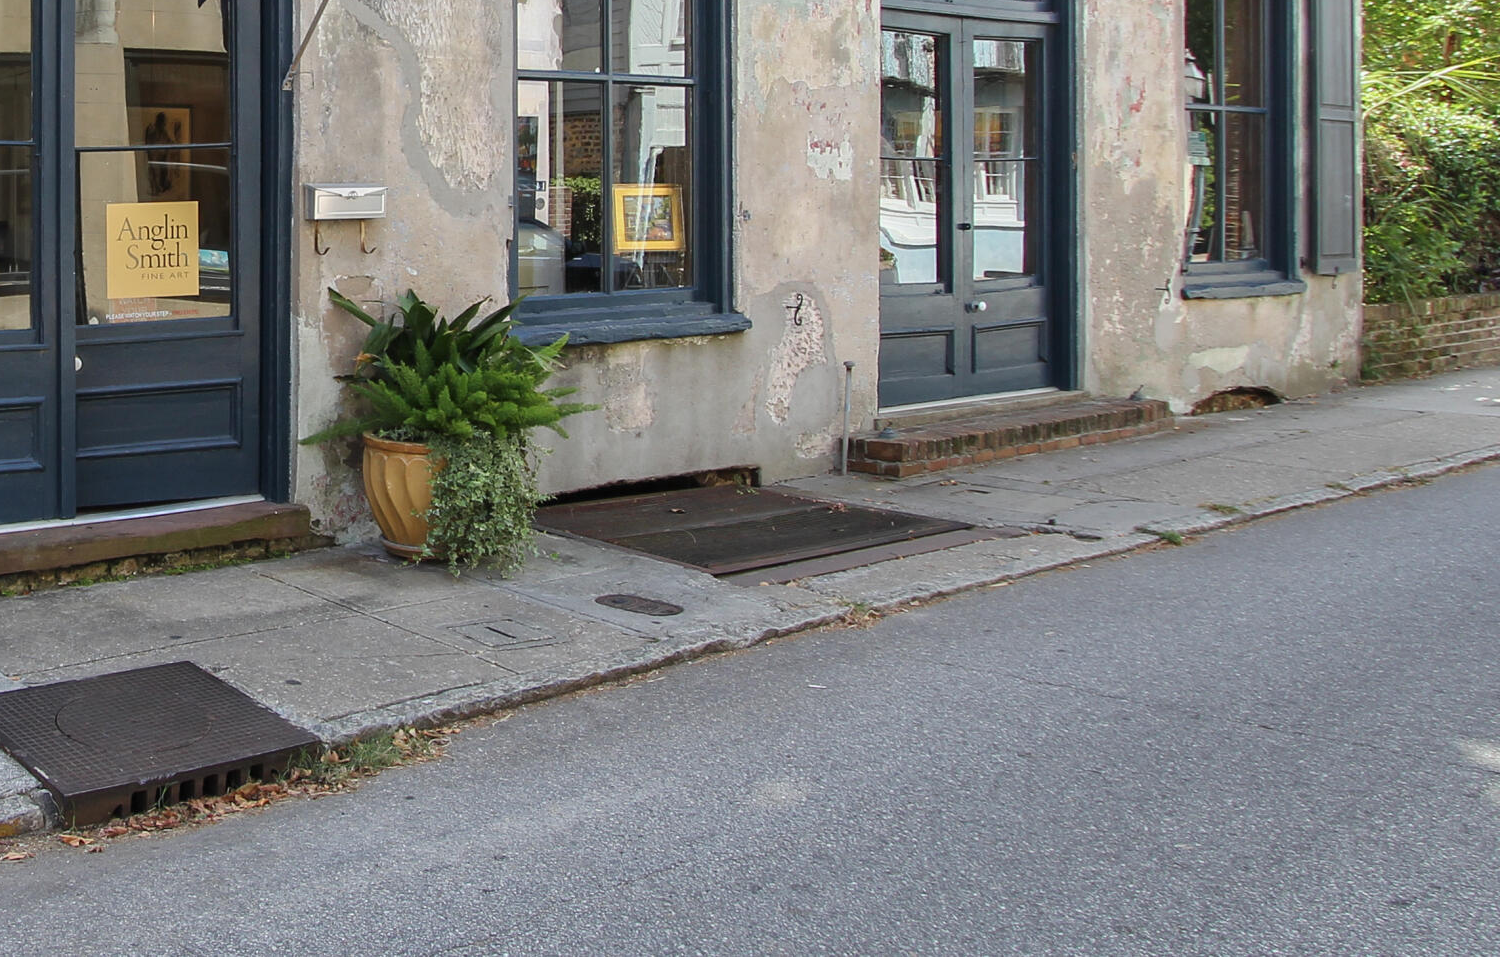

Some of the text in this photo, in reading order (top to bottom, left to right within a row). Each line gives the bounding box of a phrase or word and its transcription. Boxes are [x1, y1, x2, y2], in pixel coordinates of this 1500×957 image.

[116, 213, 189, 251] Anglin
[125, 241, 189, 271] Smith
[141, 271, 189, 281] FINE ART
